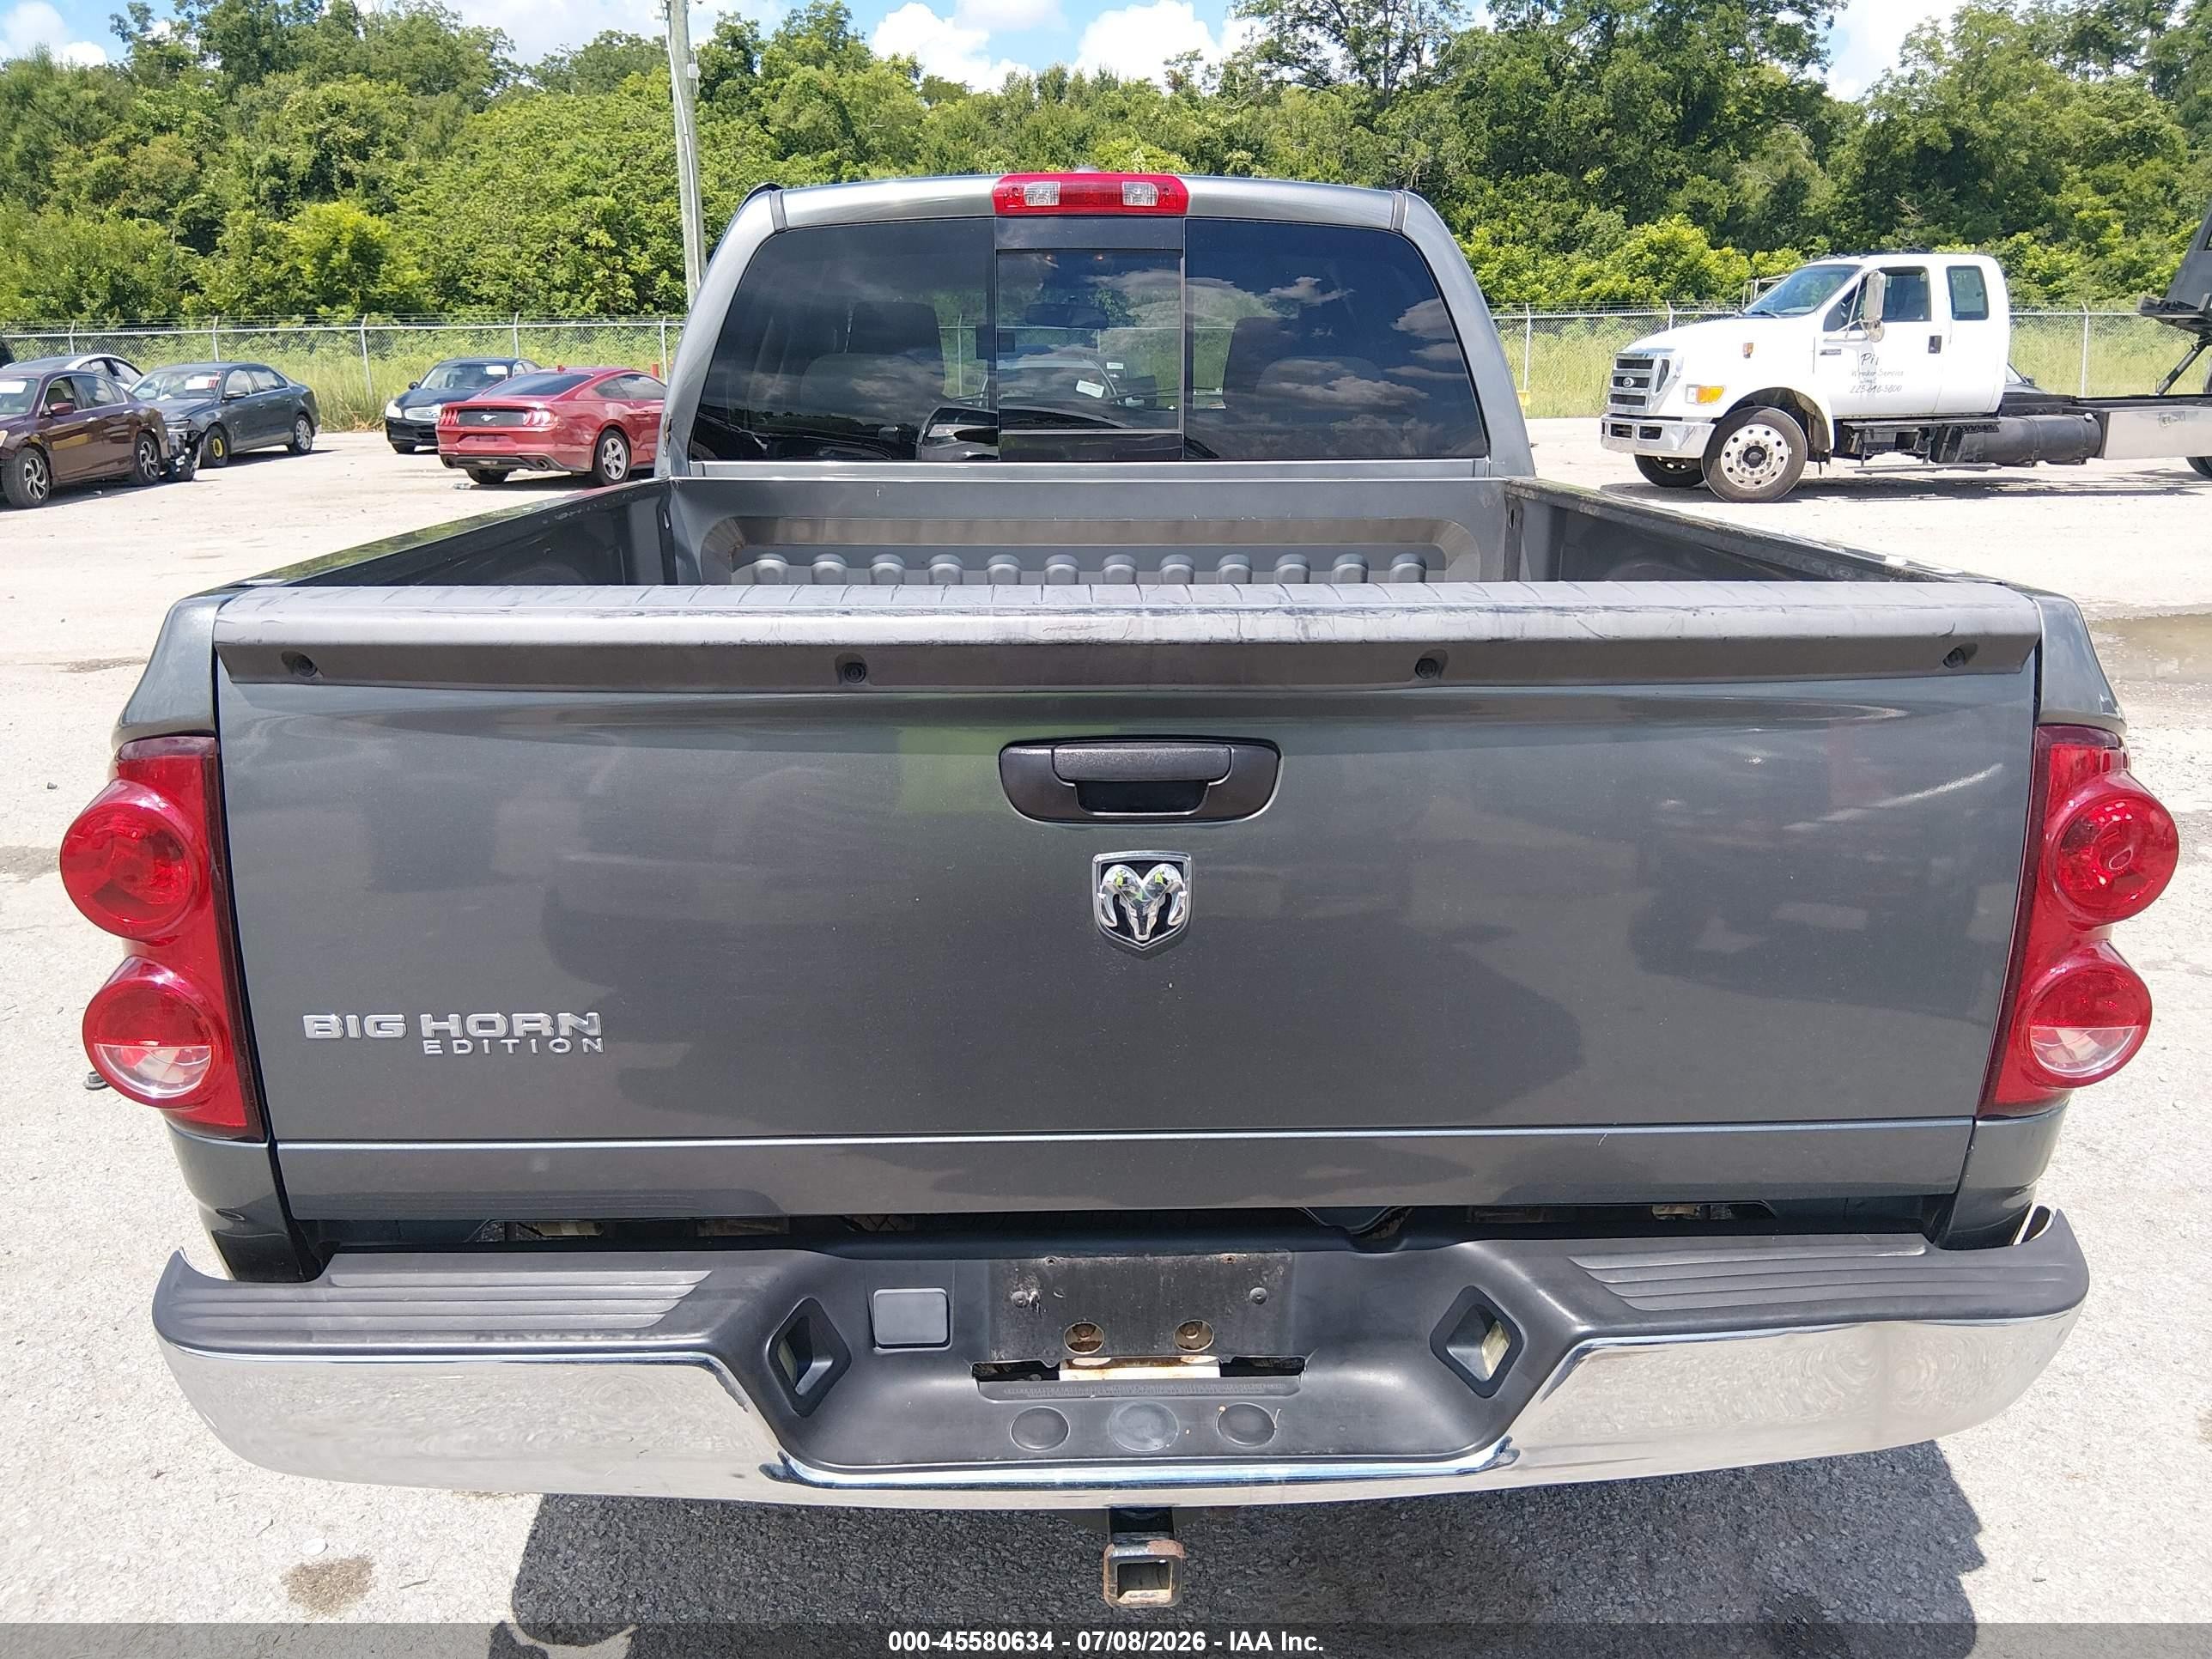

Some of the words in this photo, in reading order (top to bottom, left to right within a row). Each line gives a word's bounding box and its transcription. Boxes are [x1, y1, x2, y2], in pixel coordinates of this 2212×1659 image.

[303, 1013, 407, 1039] BIG
[420, 1012, 602, 1038] HORN
[423, 1037, 605, 1055] EDITION
